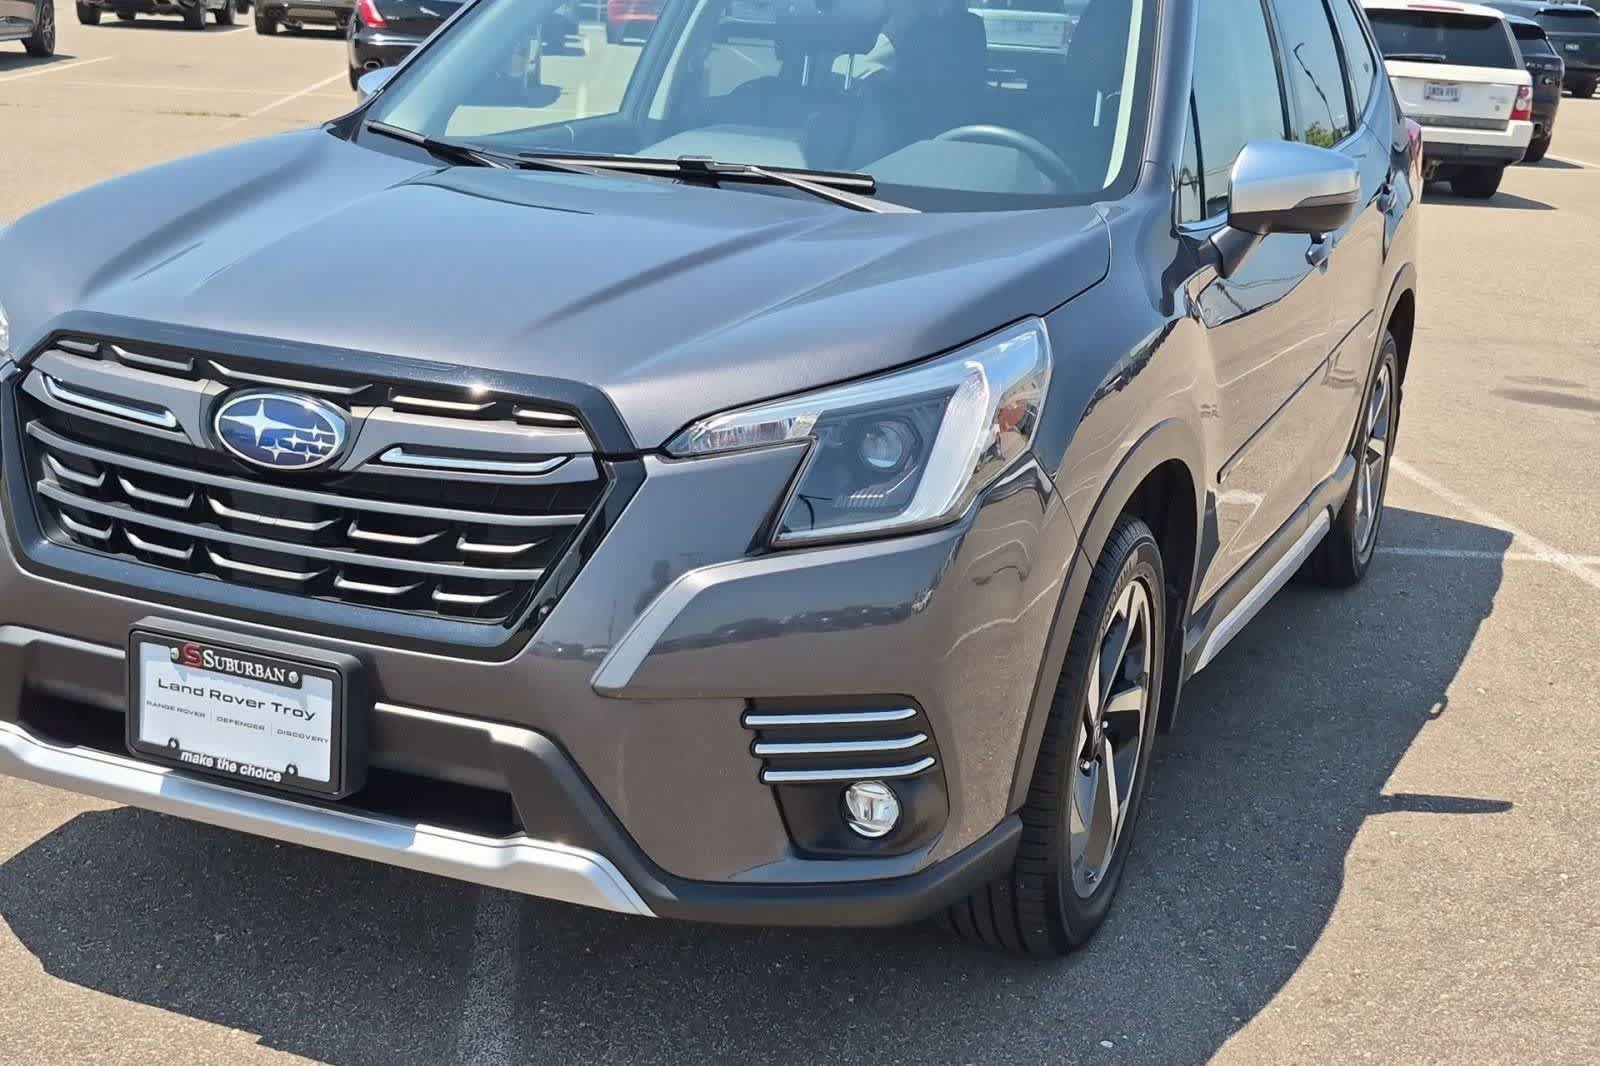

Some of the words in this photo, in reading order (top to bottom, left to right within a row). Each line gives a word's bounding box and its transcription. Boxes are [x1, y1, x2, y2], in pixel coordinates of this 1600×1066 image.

[203, 650, 286, 682] SUBURBAN
[158, 678, 204, 697] Land
[209, 689, 266, 710] Rover
[271, 702, 316, 721] Troy
[146, 700, 176, 712] RANGE
[177, 708, 206, 719] ROVER
[216, 716, 265, 731] DEFENDER
[277, 728, 329, 744] DISCOVERY
[181, 751, 214, 767] make
[217, 758, 237, 773] the
[240, 765, 282, 782] choice
